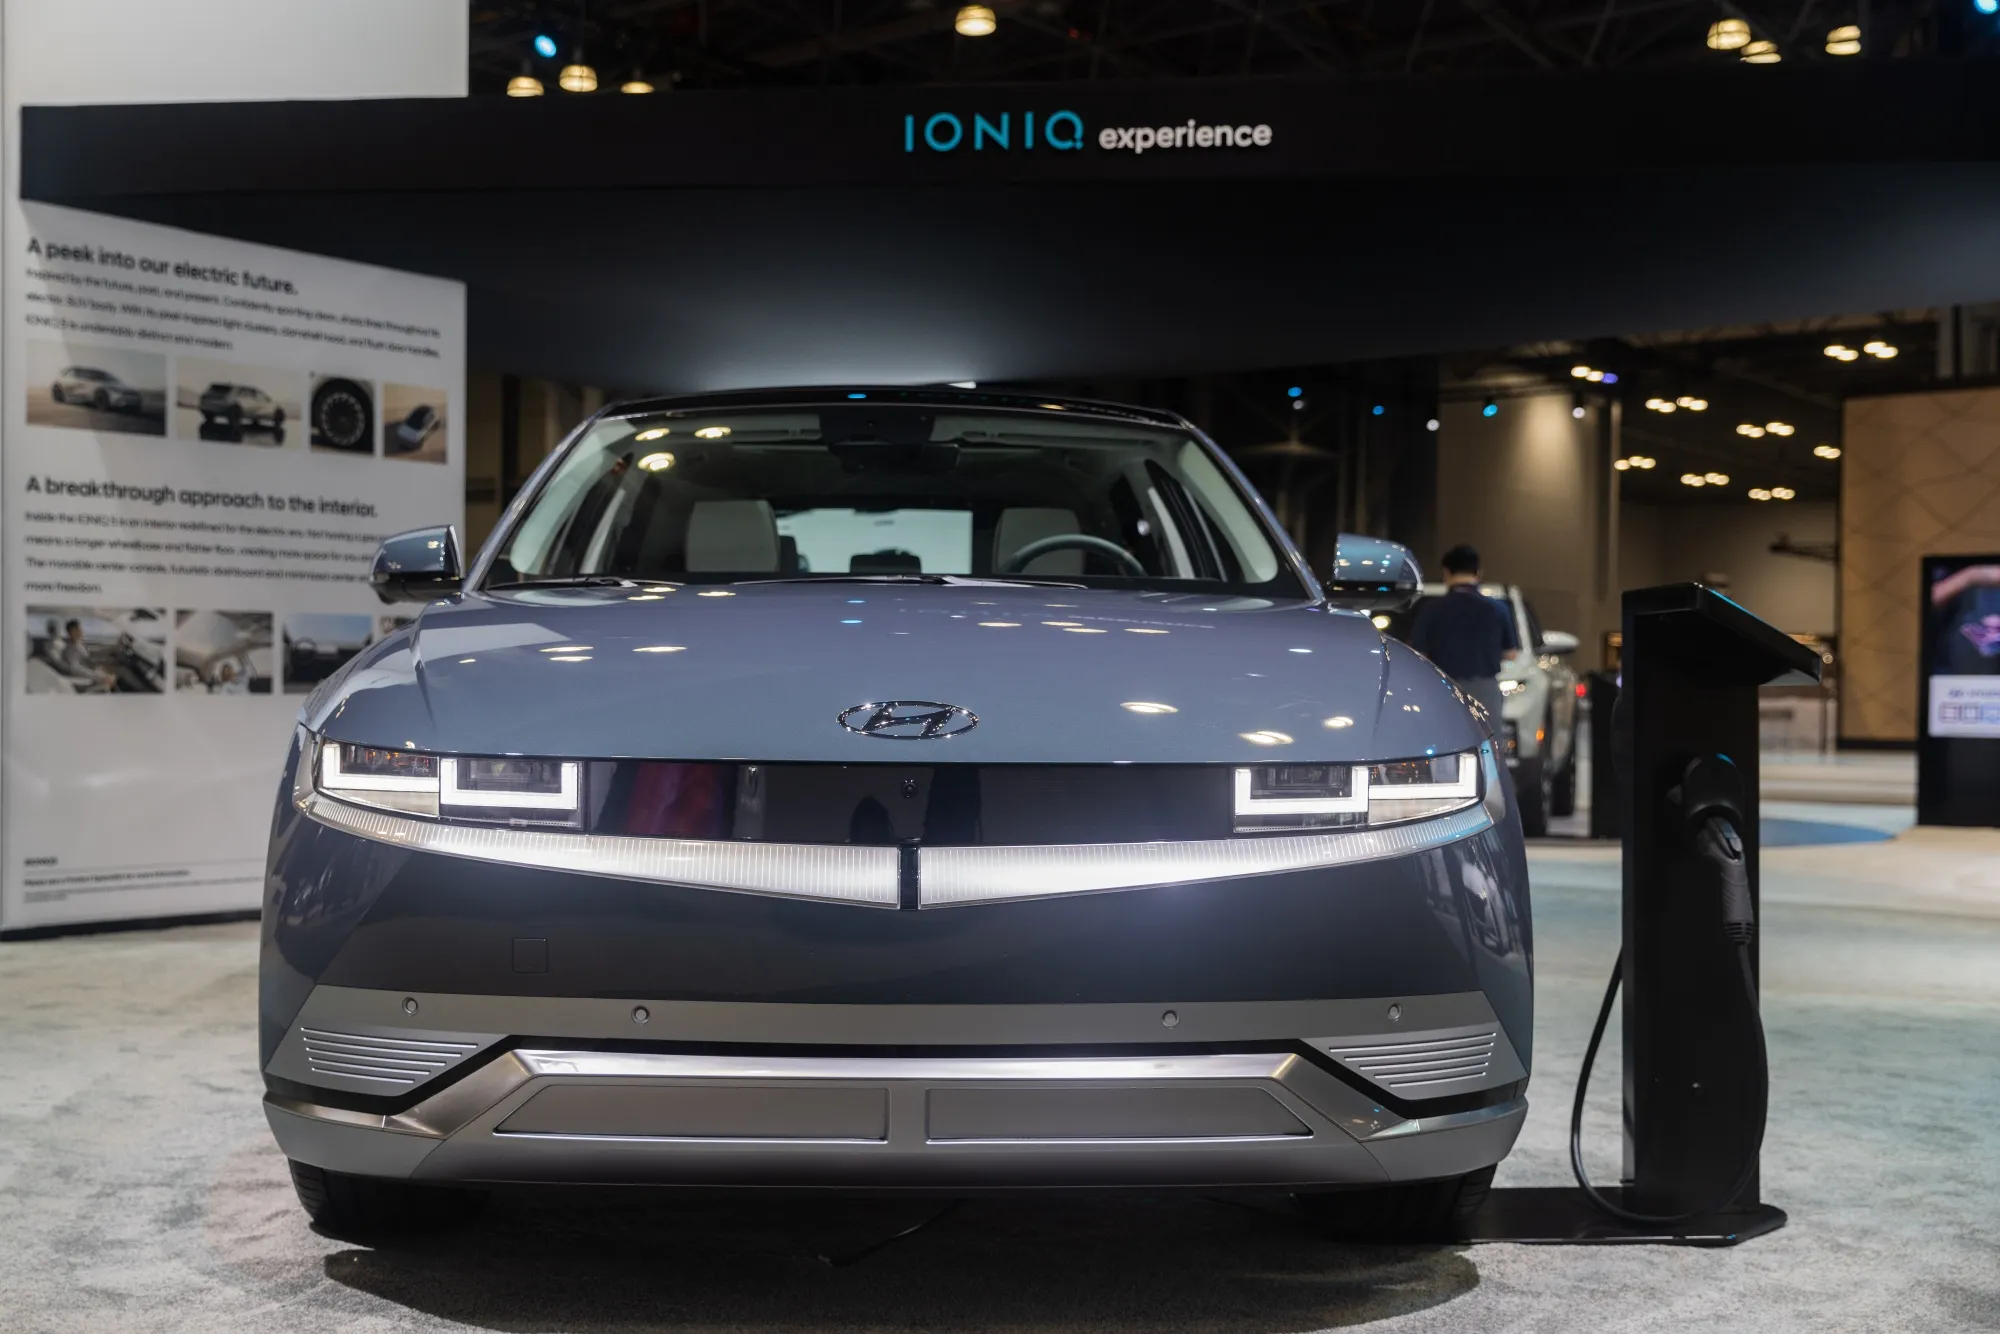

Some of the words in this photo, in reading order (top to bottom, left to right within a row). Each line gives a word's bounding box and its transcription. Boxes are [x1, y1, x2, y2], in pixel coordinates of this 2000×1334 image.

[904, 111, 1084, 152] IONIQ
[1098, 119, 1273, 153] experience
[28, 237, 42, 254] A
[46, 243, 96, 265] peek
[98, 245, 136, 270] into
[139, 257, 170, 275] our
[173, 260, 240, 286] electric
[242, 269, 299, 296] future.
[26, 475, 42, 494] A
[45, 476, 176, 506] breakthrough
[179, 489, 265, 510] approach
[267, 495, 286, 511] to
[288, 495, 316, 514] the
[318, 495, 378, 518] interior.
